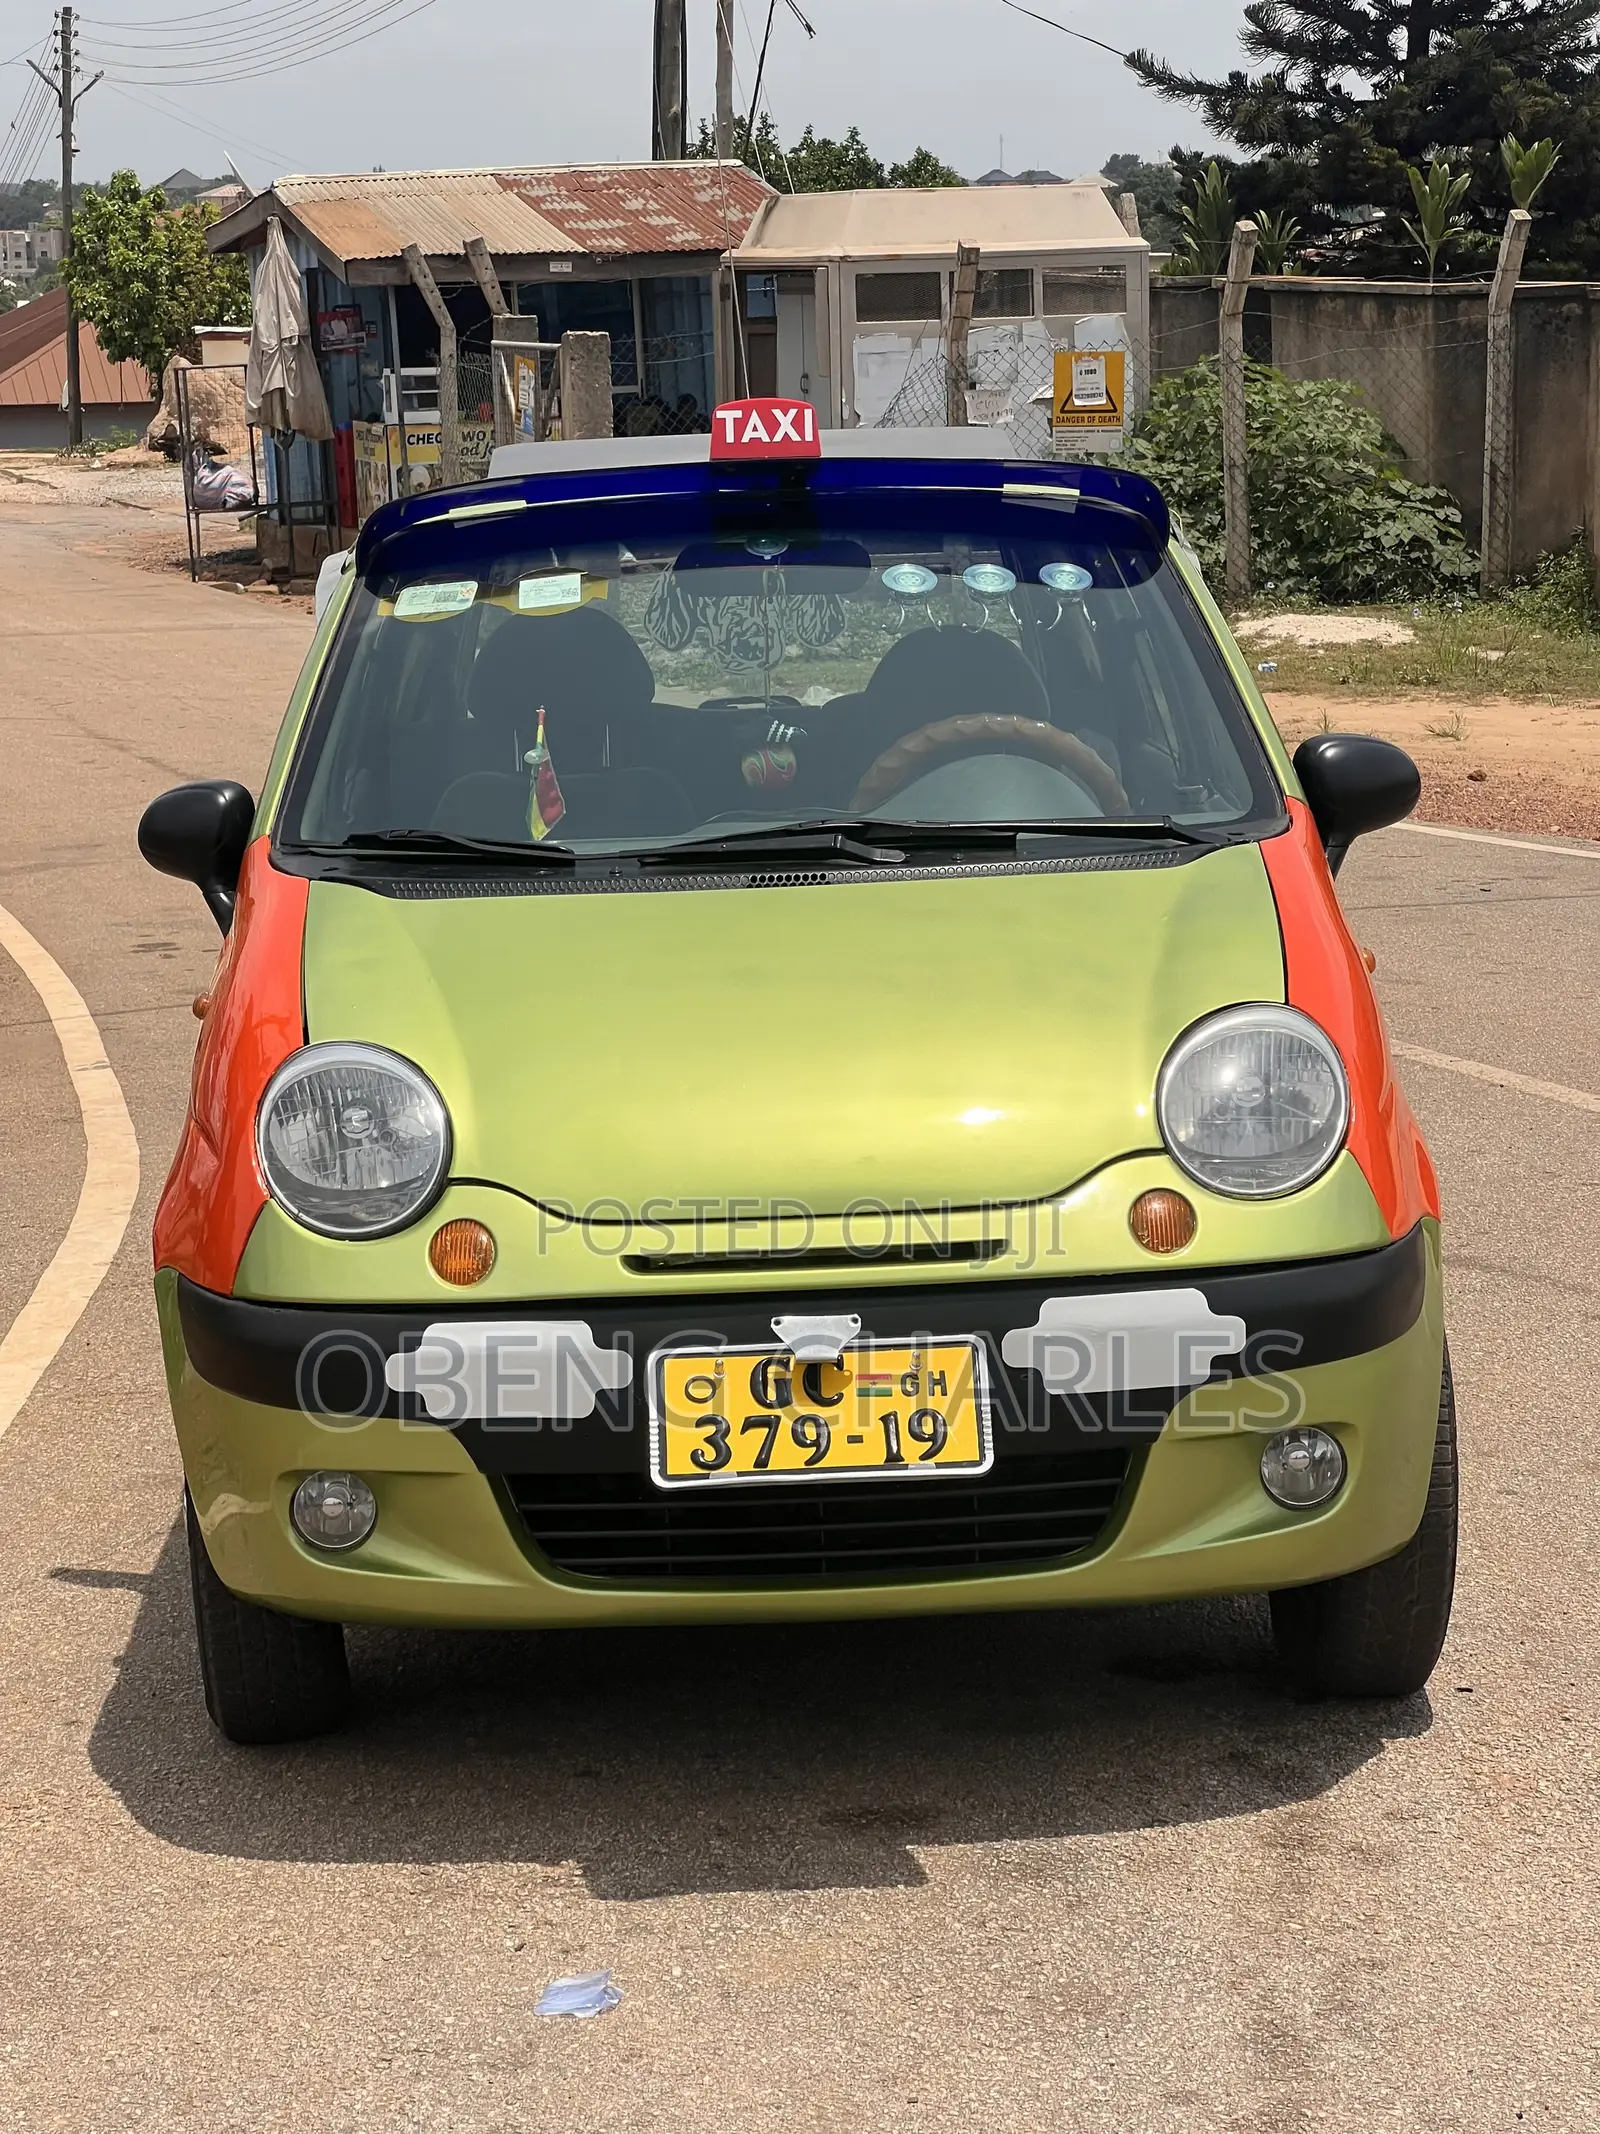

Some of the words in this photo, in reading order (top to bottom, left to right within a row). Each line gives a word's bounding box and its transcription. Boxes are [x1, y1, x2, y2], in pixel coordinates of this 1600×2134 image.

[716, 408, 813, 443] TAXI
[1056, 415, 1085, 424] DANGER
[1087, 415, 1096, 424] OF
[1098, 415, 1121, 424] DEATH
[750, 1355, 844, 1409] GC
[901, 1370, 948, 1397] GH
